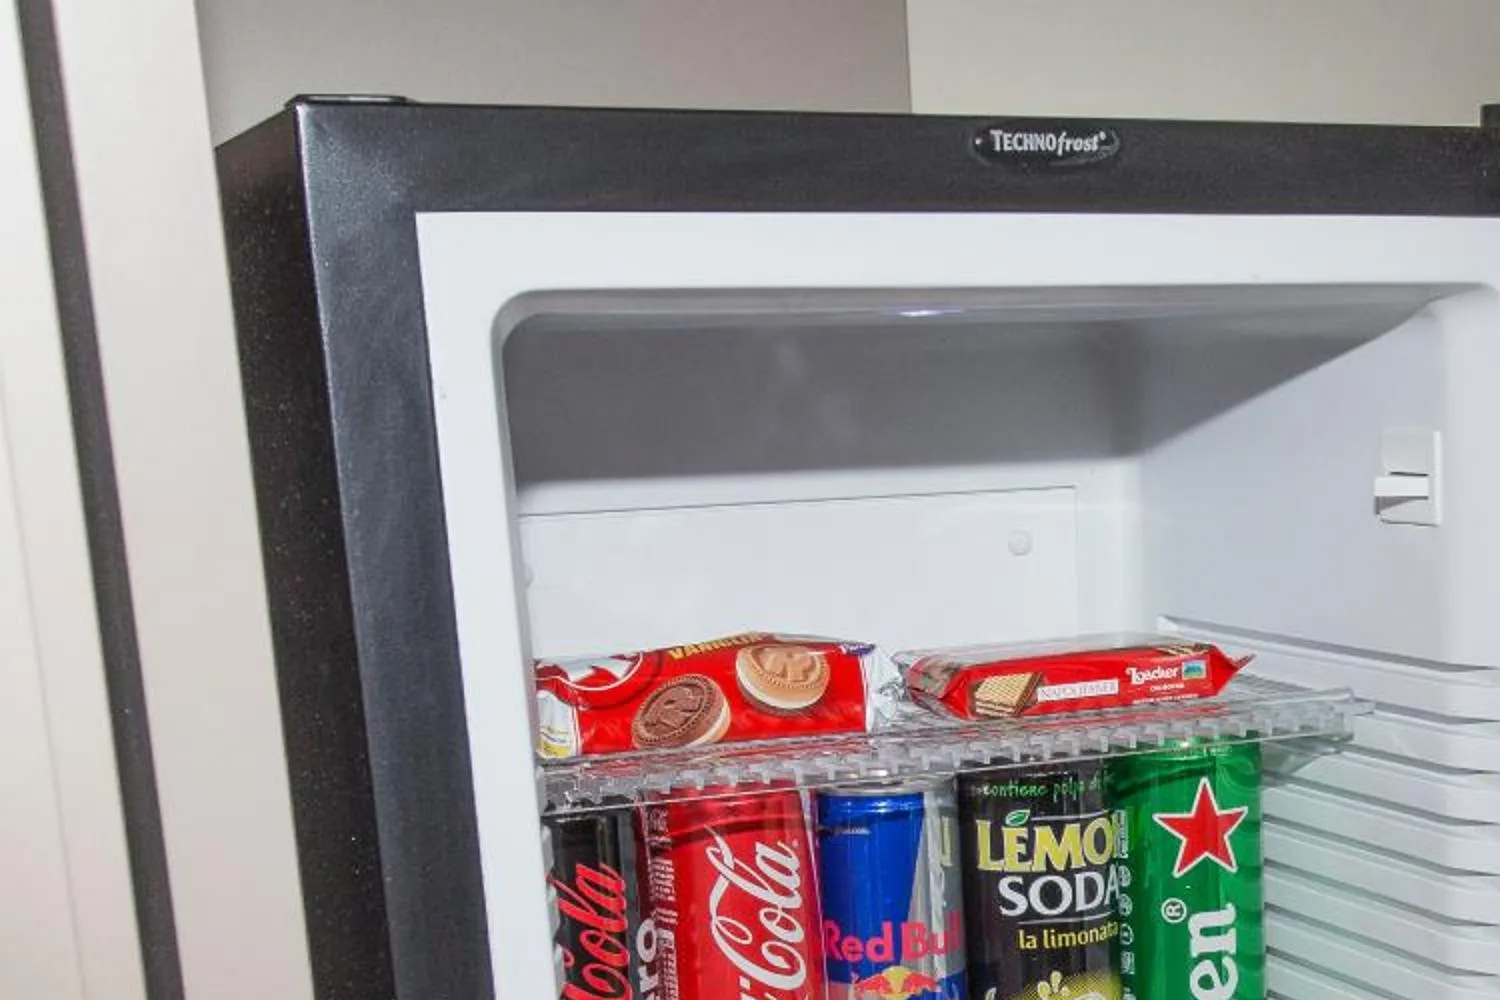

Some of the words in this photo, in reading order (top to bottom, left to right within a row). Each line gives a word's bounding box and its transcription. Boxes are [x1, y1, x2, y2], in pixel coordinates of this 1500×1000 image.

[989, 129, 1100, 156] TECHNOfrost
[998, 863, 1120, 917] SODA
[823, 920, 895, 962] Red
[1018, 929, 1037, 949] la
